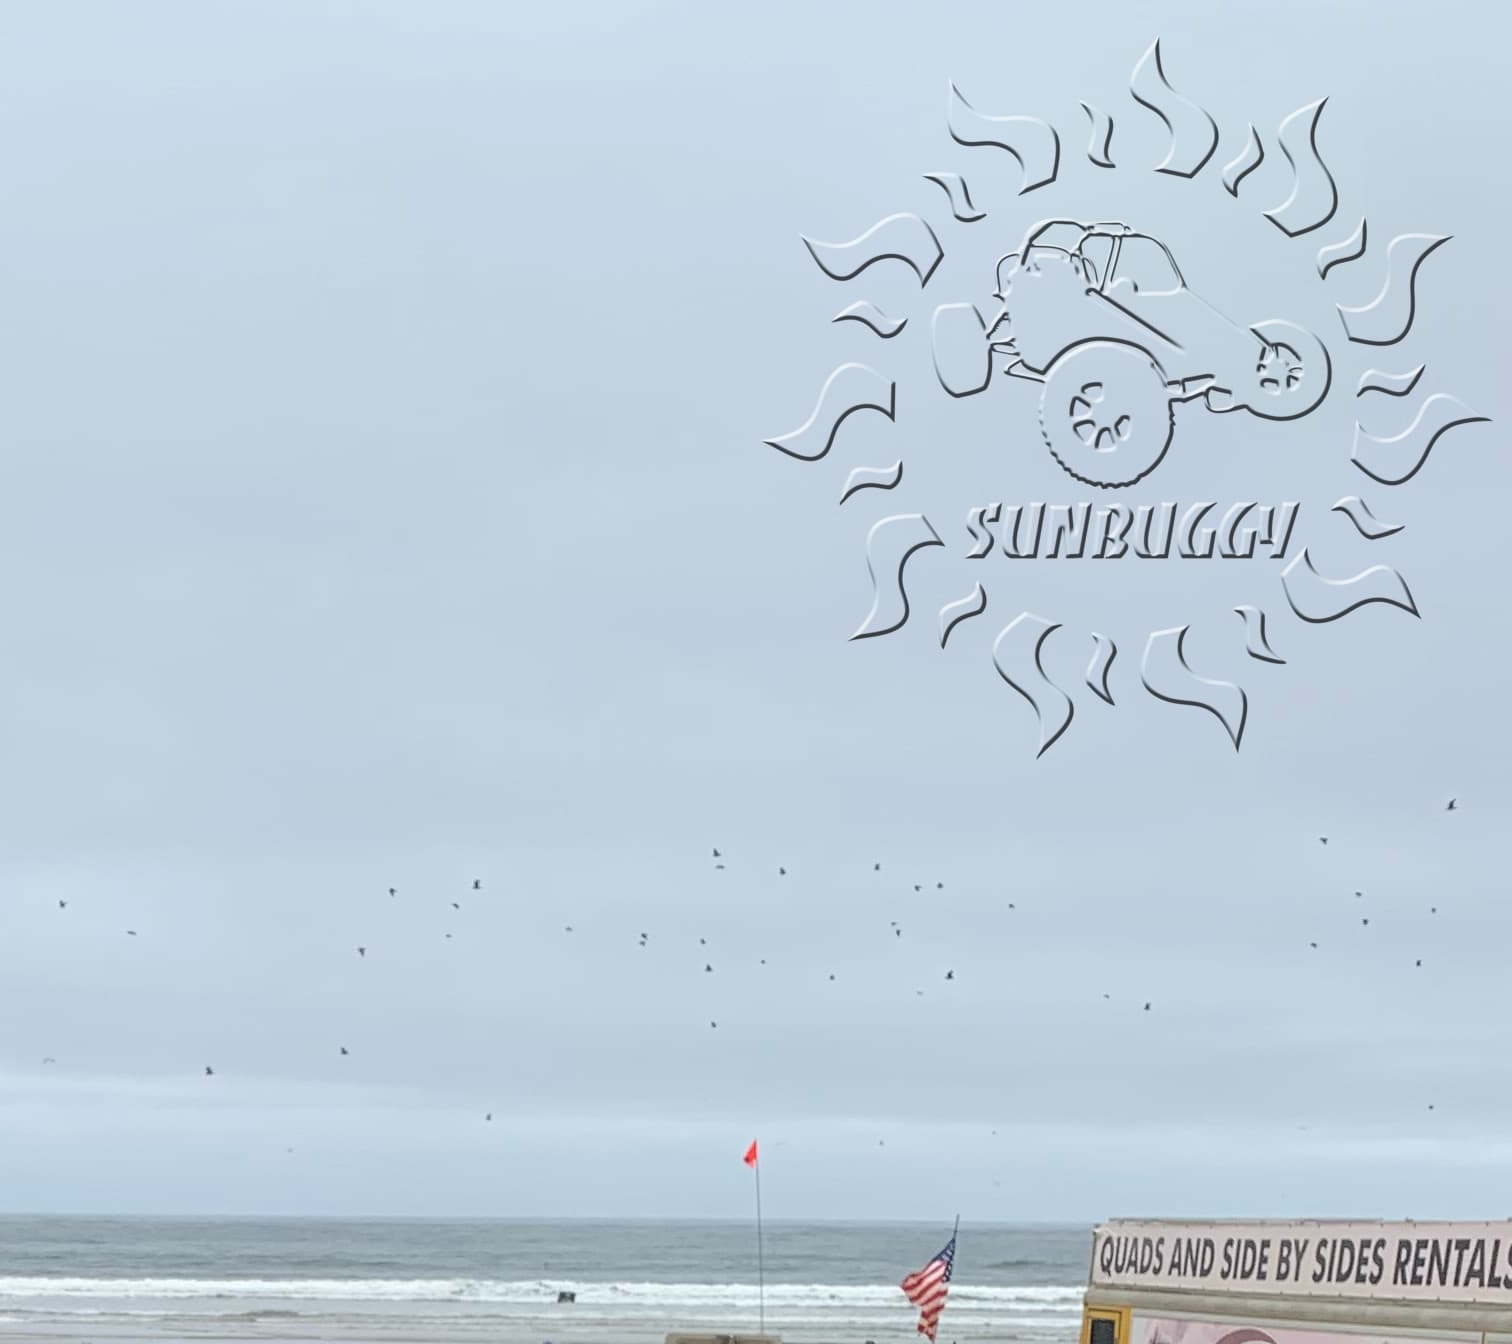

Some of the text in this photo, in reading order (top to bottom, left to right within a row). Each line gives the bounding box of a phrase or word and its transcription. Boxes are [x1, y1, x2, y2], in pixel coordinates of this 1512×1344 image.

[1100, 1235, 1165, 1276] QUADS
[1168, 1237, 1216, 1277] AND
[1220, 1238, 1271, 1280] SIDE
[1276, 1239, 1309, 1282] BY
[1312, 1237, 1387, 1285] SIDES
